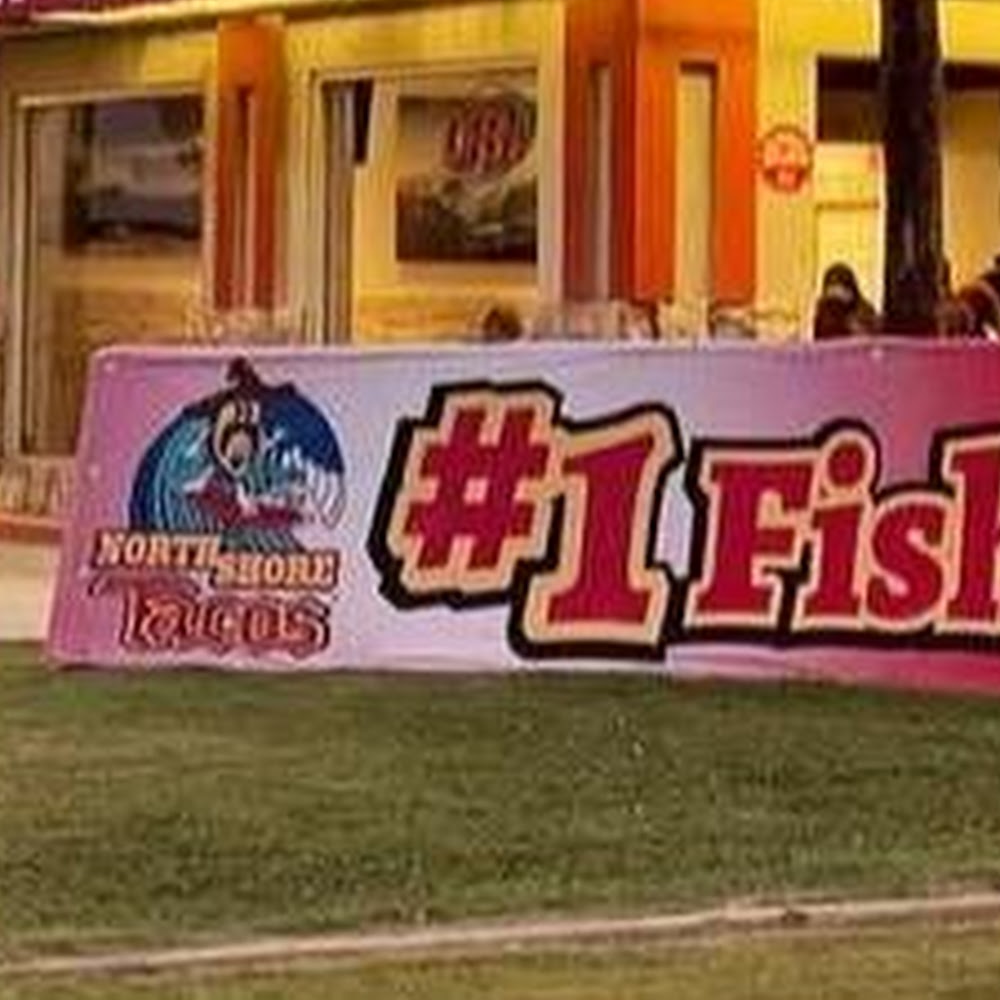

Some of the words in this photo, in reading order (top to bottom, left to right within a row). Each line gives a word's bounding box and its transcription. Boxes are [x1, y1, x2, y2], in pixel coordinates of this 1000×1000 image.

[93, 531, 223, 568] NORTH
[212, 552, 339, 591] SHORE
[376, 383, 682, 656] #1
